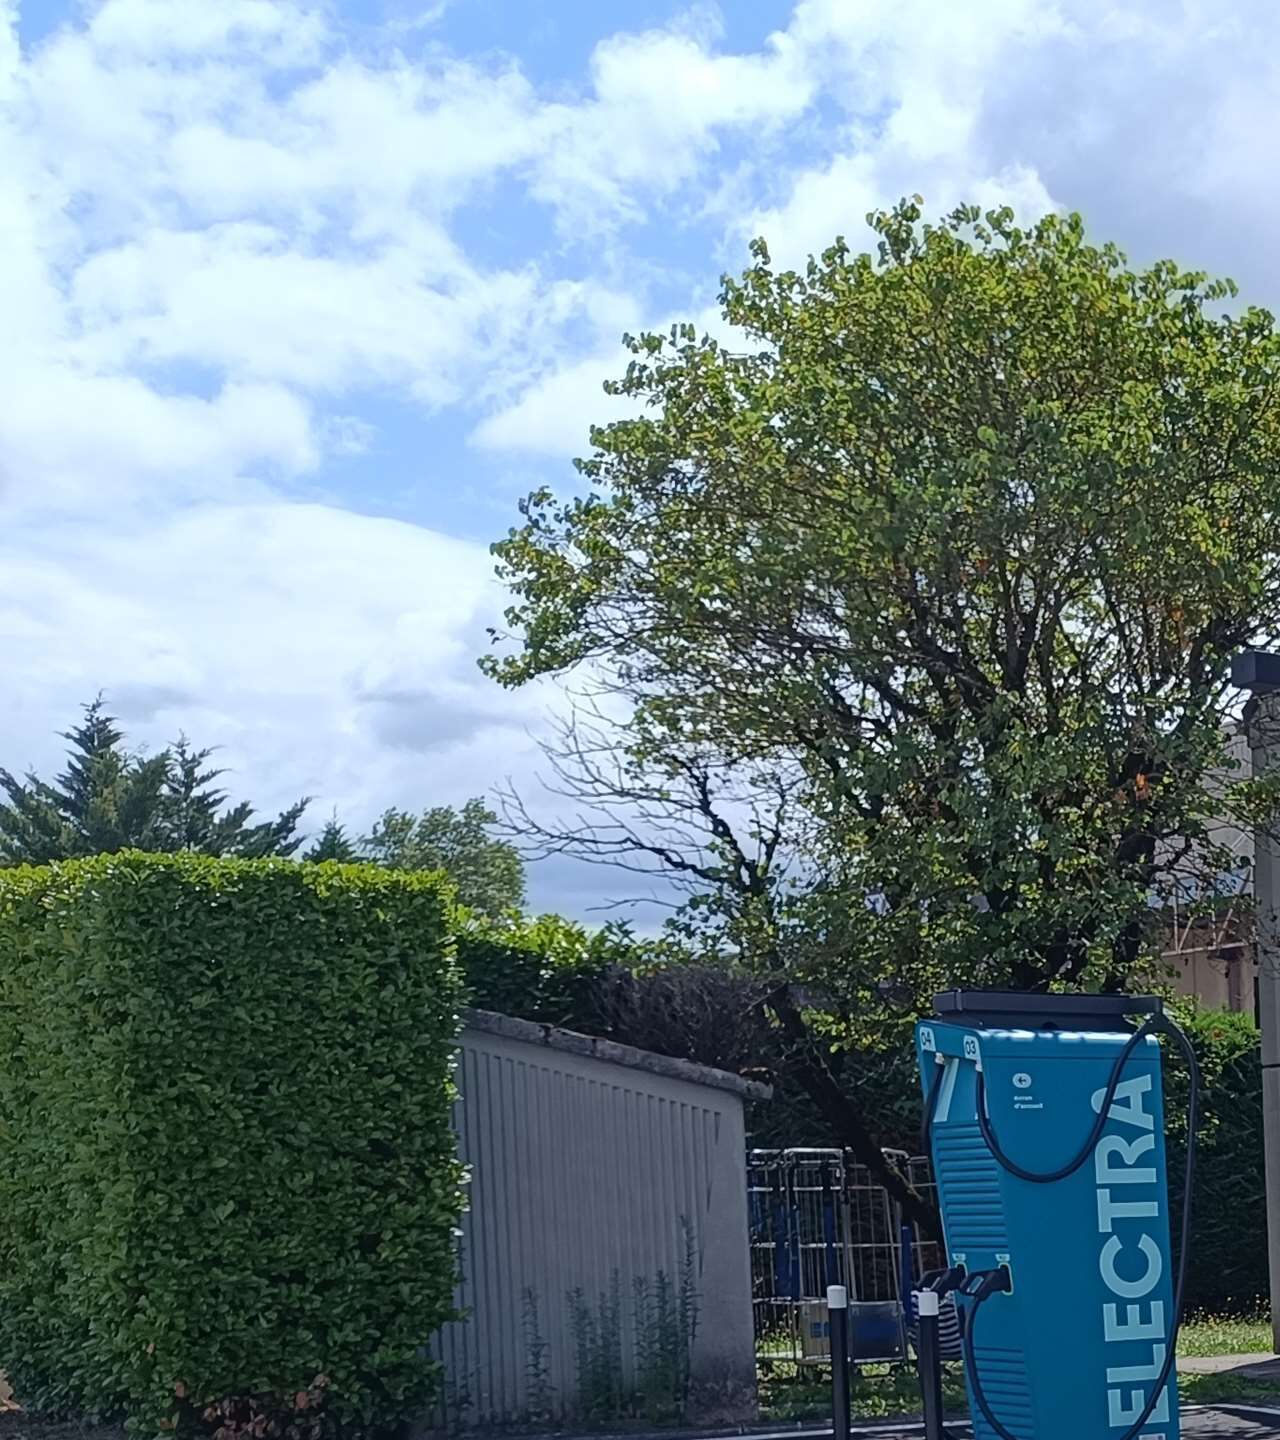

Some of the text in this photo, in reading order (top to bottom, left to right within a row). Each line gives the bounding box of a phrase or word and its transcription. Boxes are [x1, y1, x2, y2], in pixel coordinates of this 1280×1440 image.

[921, 1031, 932, 1046] 04
[965, 1040, 977, 1055] 03
[1091, 1073, 1170, 1427] ELECTRA
